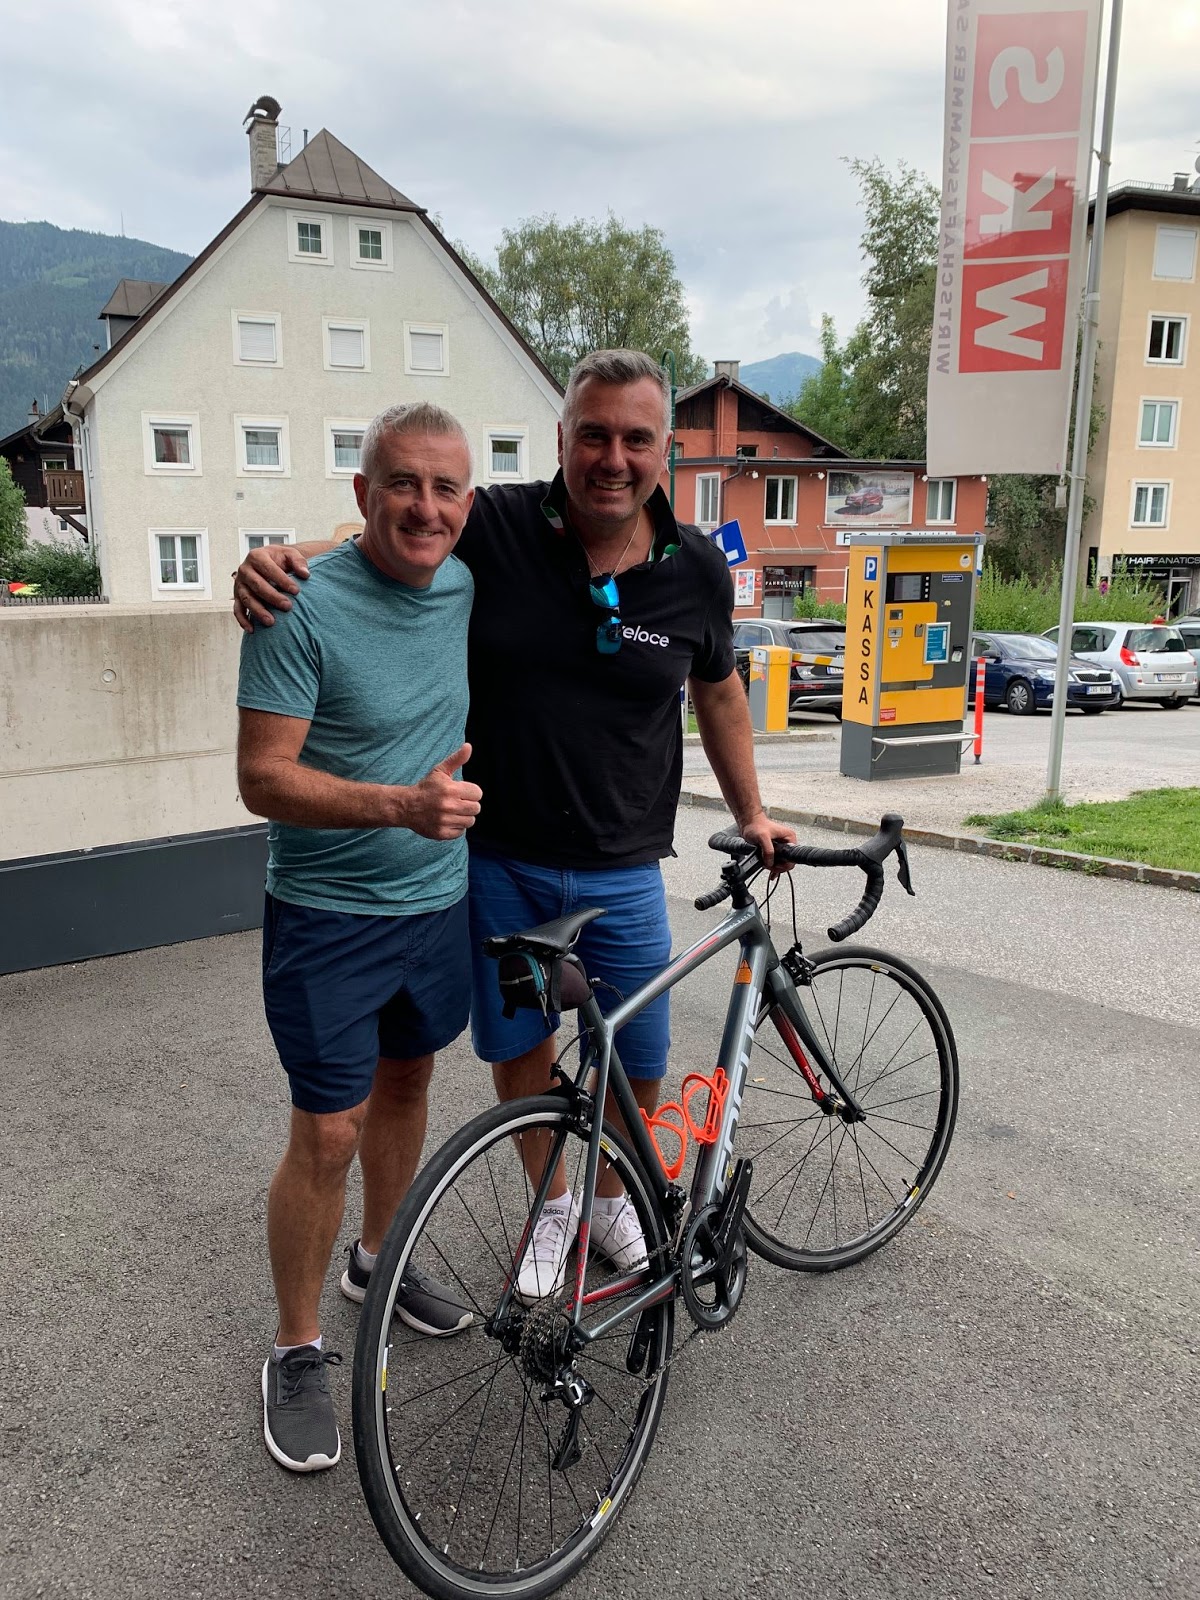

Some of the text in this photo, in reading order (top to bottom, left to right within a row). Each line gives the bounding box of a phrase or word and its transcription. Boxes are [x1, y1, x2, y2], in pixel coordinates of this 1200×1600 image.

[866, 558, 876, 578] P
[621, 625, 670, 647] eloce
[858, 589, 874, 705] KASSA
[542, 1207, 565, 1216] adidas
